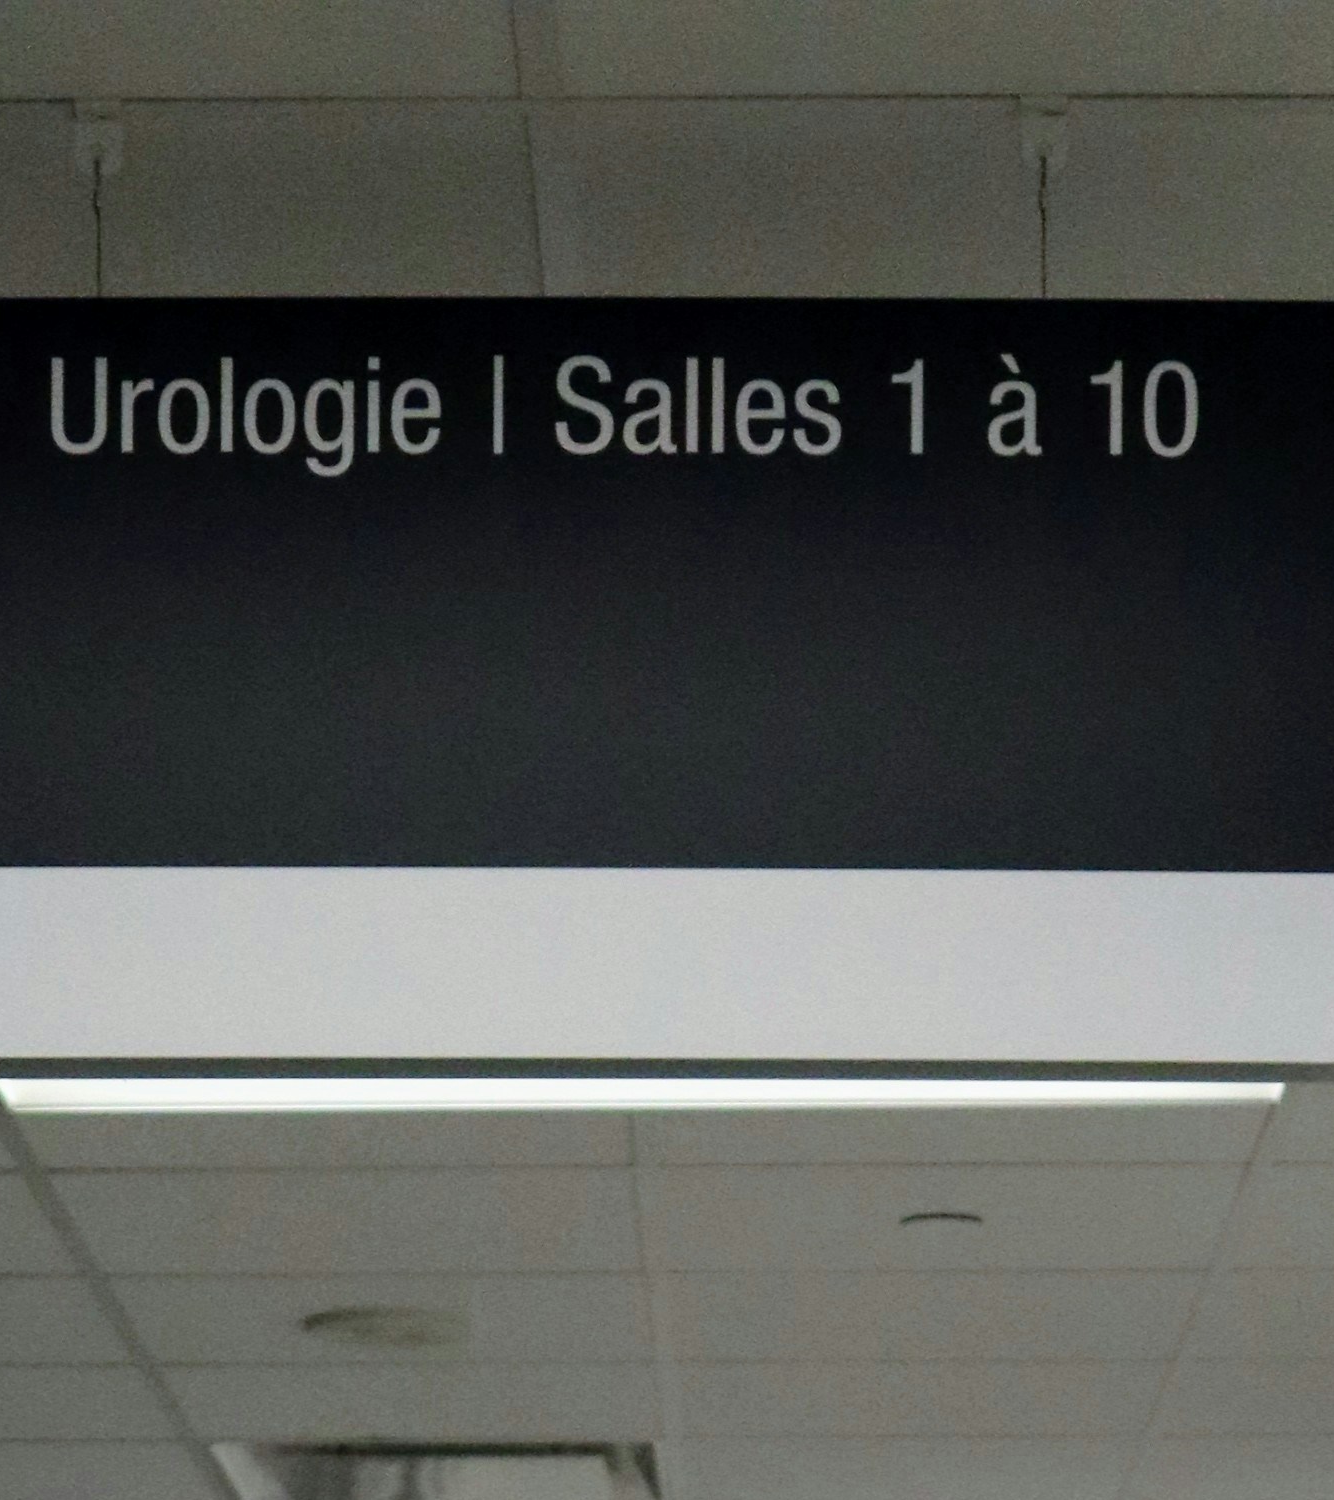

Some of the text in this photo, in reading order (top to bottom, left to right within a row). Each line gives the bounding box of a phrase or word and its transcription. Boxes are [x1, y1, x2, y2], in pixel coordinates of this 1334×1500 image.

[48, 355, 442, 479] Urologie
[553, 355, 842, 456] Salles
[889, 358, 926, 456] 1
[985, 353, 1043, 458] à
[1089, 359, 1200, 460] 10
